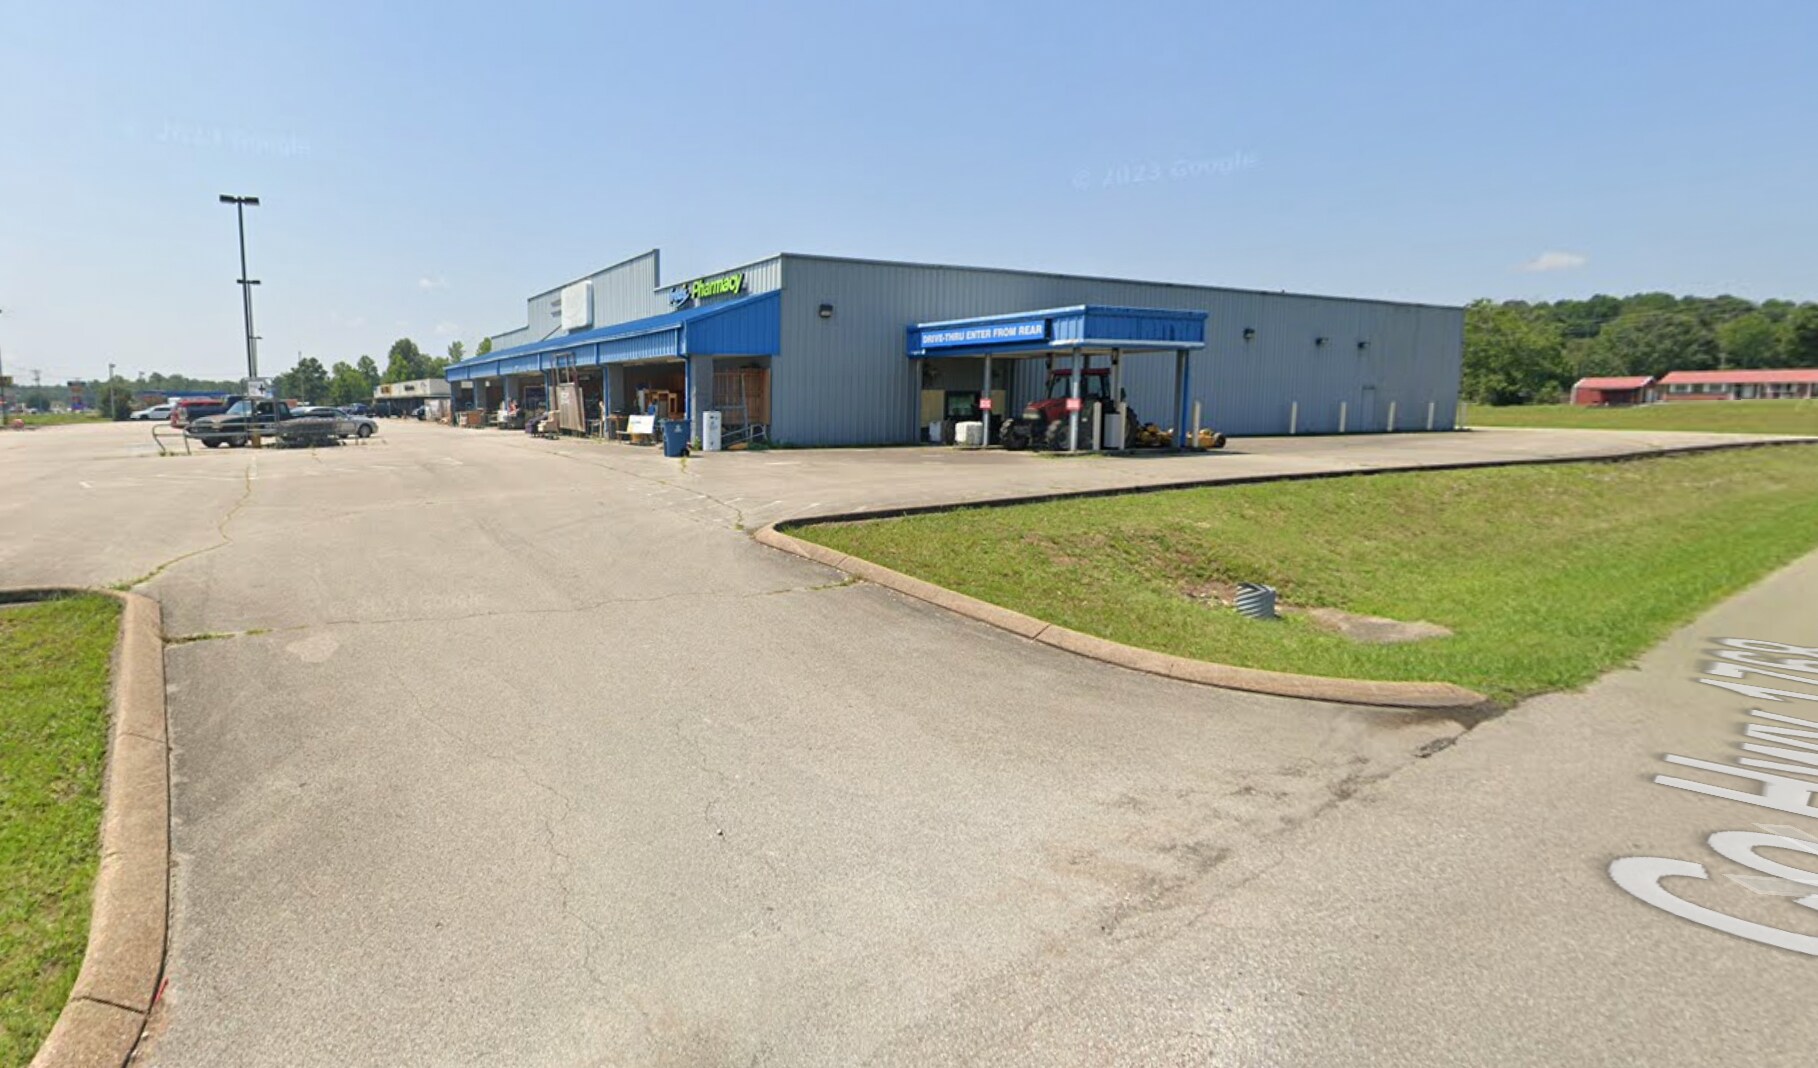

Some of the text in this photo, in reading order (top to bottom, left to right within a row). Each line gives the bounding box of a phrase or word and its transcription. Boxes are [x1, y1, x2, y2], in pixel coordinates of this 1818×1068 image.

[691, 272, 743, 299] Pharmacy
[922, 324, 1042, 344] DRIVE-THRU ENTER FROM REAR
